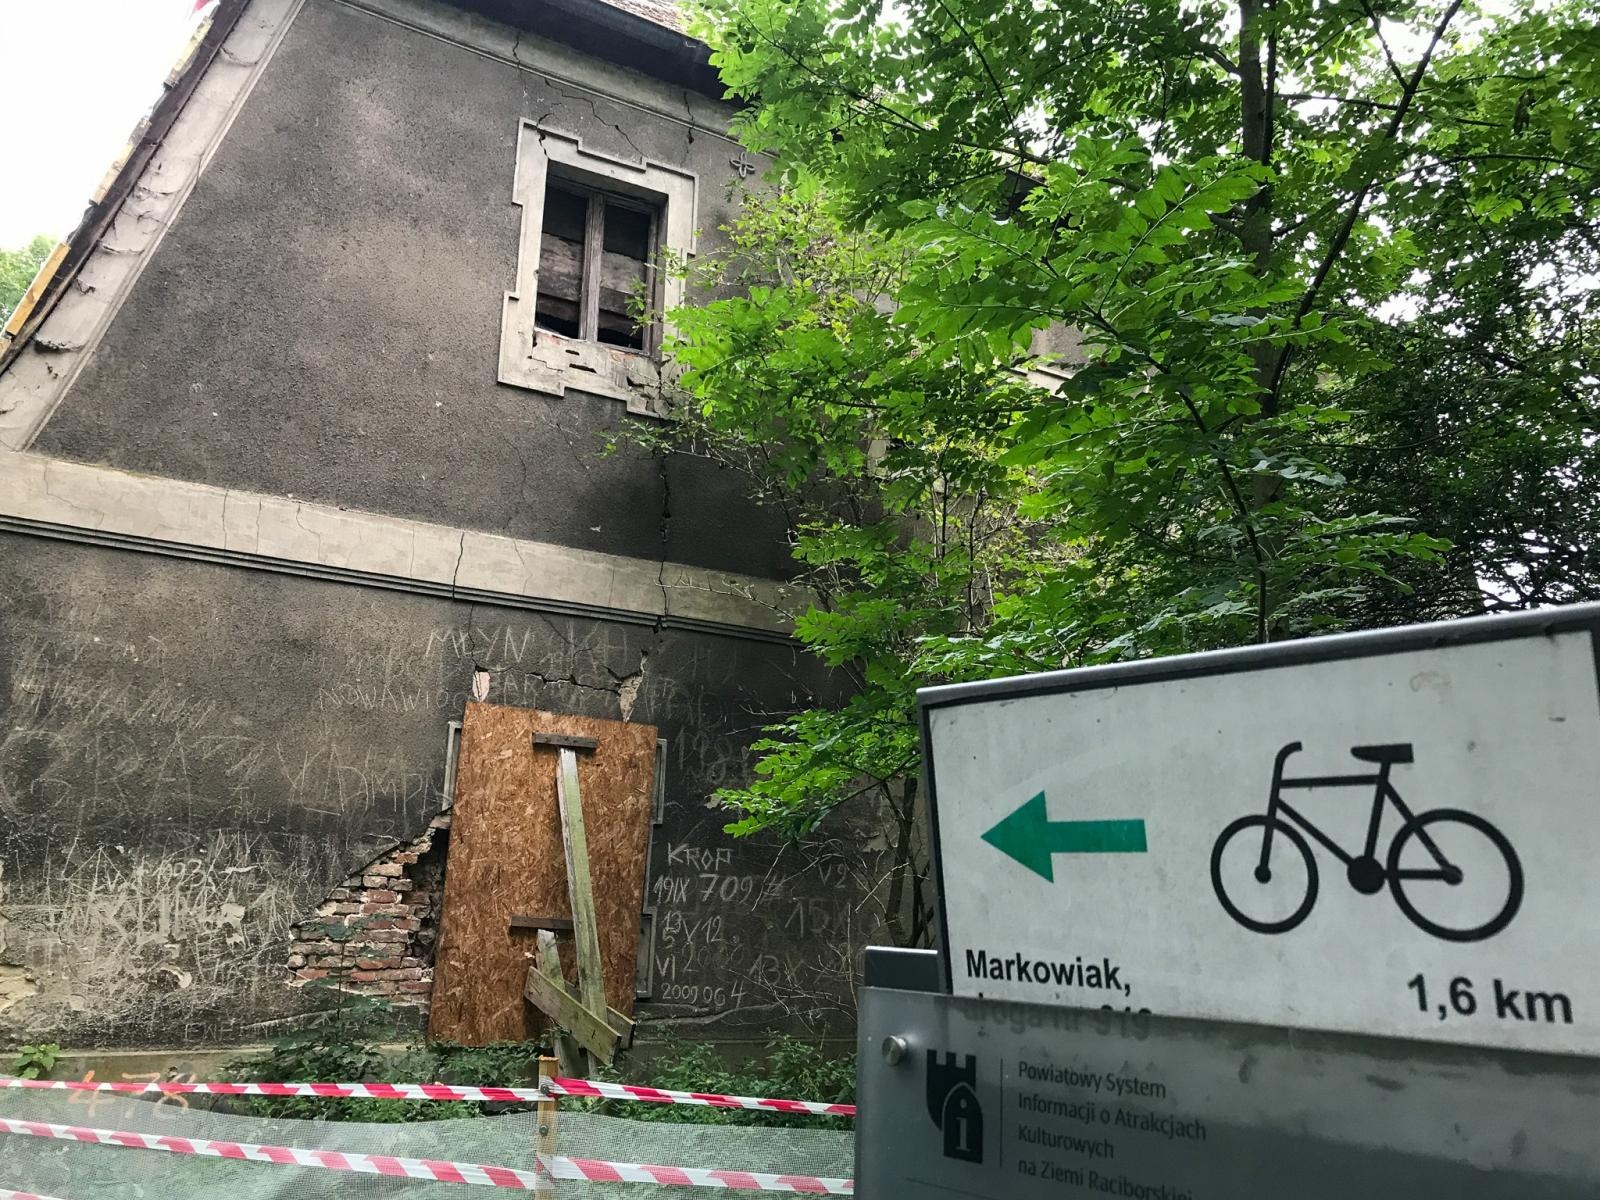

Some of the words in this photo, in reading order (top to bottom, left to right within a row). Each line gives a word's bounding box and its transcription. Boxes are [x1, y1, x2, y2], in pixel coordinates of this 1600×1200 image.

[965, 948, 1131, 997] Markowiak,
[1407, 972, 1477, 1021] 1,6
[1493, 978, 1573, 1024] km
[1018, 1060, 1103, 1093] Powiatowy
[1105, 1072, 1167, 1099] System
[1018, 1092, 1097, 1125] Informacji
[1100, 1109, 1111, 1124] o
[1114, 1106, 1207, 1141] Atrakcjach
[1018, 1124, 1115, 1160] Kulturowych
[1018, 1159, 1037, 1177] na
[1040, 1160, 1085, 1187] Ziemi
[1088, 1170, 1193, 1200] Raciborski
